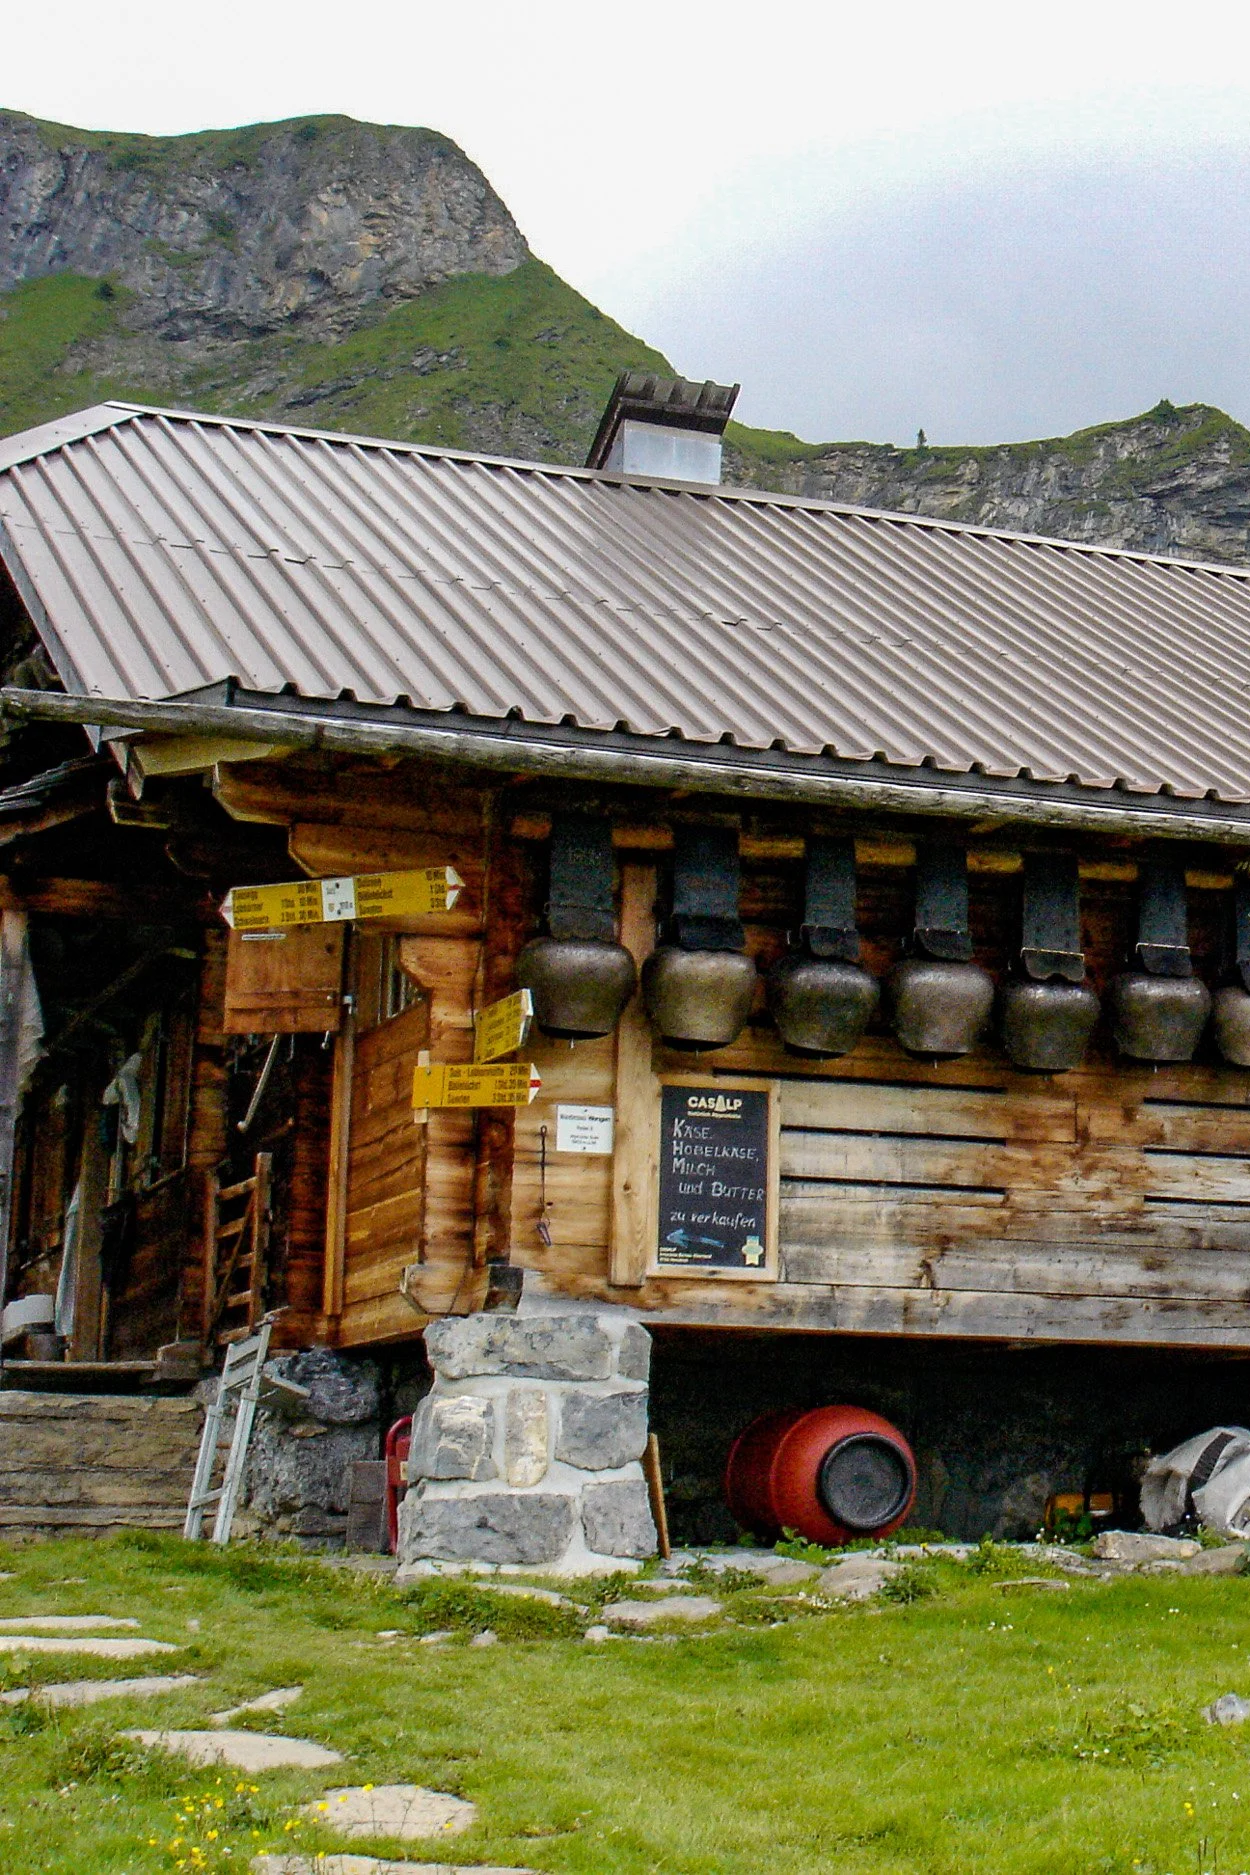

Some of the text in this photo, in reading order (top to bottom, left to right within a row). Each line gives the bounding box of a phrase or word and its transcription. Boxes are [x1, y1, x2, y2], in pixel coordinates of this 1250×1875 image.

[687, 1095, 742, 1112] CASALP
[679, 1181, 703, 1195] und
[670, 1210, 757, 1230] zu verkaufen
